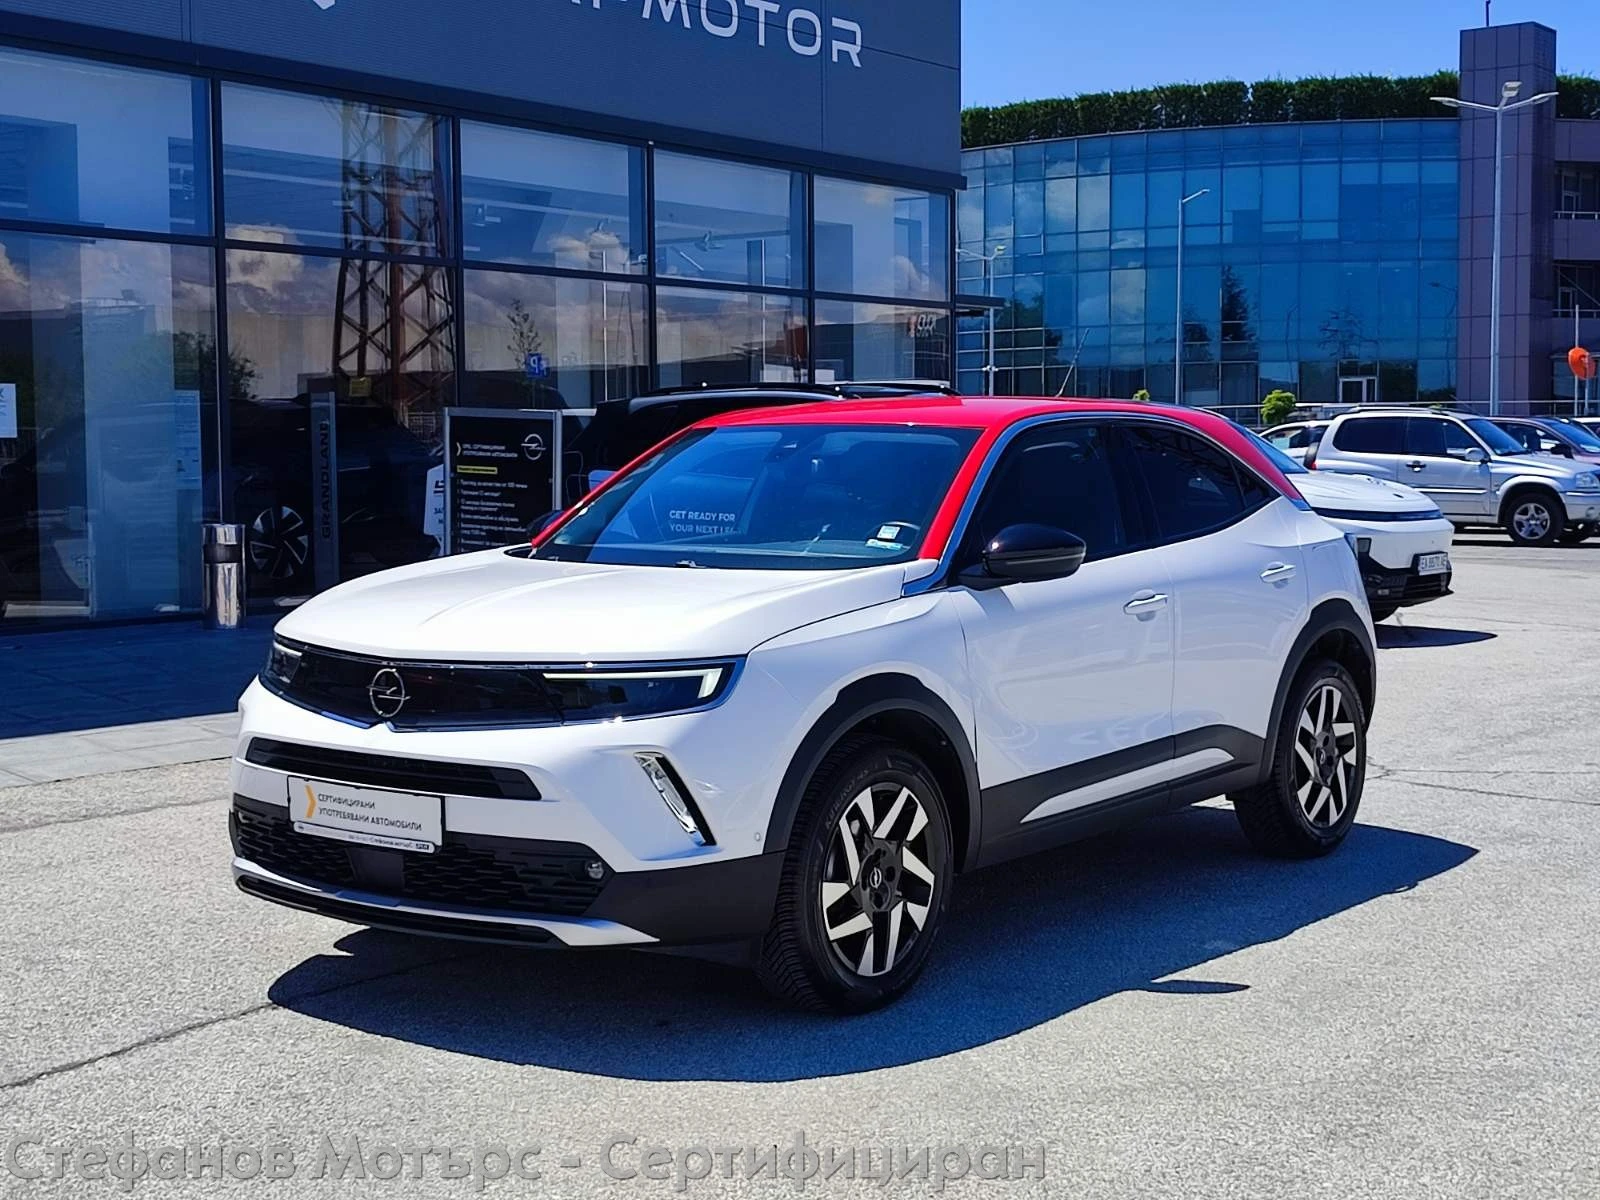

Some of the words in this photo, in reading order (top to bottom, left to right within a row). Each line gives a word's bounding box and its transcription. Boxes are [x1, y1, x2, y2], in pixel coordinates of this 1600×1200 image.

[319, 422, 330, 539] GRANDLAND
[669, 510, 686, 520] GET
[687, 511, 717, 522] READY
[718, 512, 736, 523] FOR
[670, 524, 696, 534] YOUR
[318, 793, 376, 809] СЕРТИФИЦИРАНИ
[319, 808, 370, 823] УПОТРЕБЯВАНИ
[371, 817, 422, 831] АВТОМОБИЛИ
